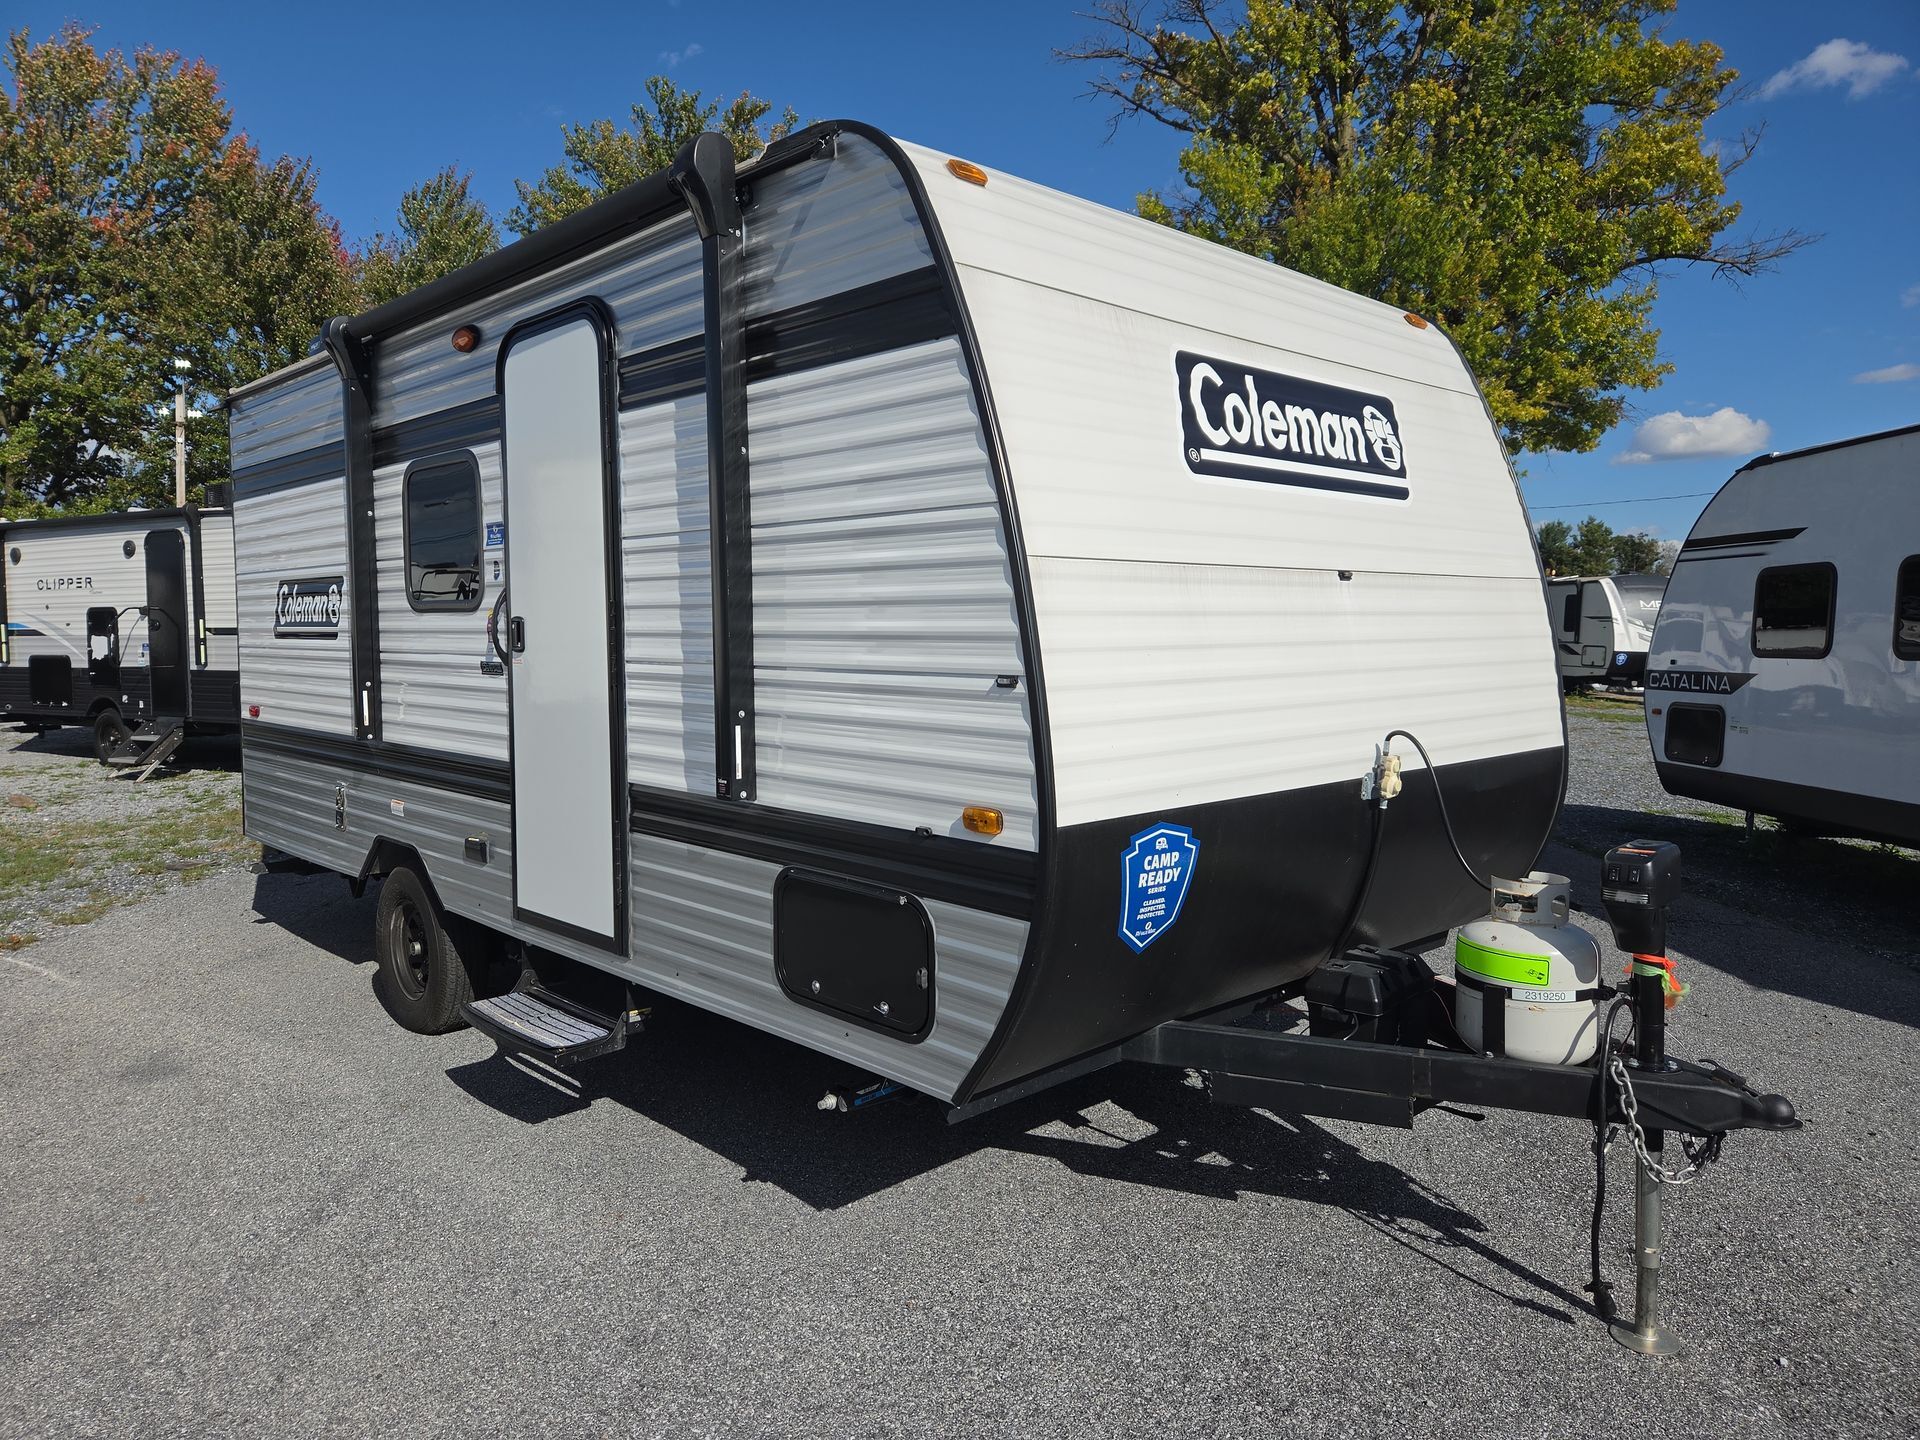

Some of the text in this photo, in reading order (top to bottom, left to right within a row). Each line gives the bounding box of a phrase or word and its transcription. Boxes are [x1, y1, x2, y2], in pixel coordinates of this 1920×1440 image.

[1190, 362, 1368, 463] Coleman
[37, 577, 93, 590] CLIPPER
[278, 584, 328, 625] Coleman
[1649, 673, 1731, 691] CATALINA
[1144, 852, 1179, 870] CAMP
[1138, 867, 1181, 888] READY
[1147, 886, 1166, 894] SERIES
[1525, 991, 1566, 1001] 2319250
